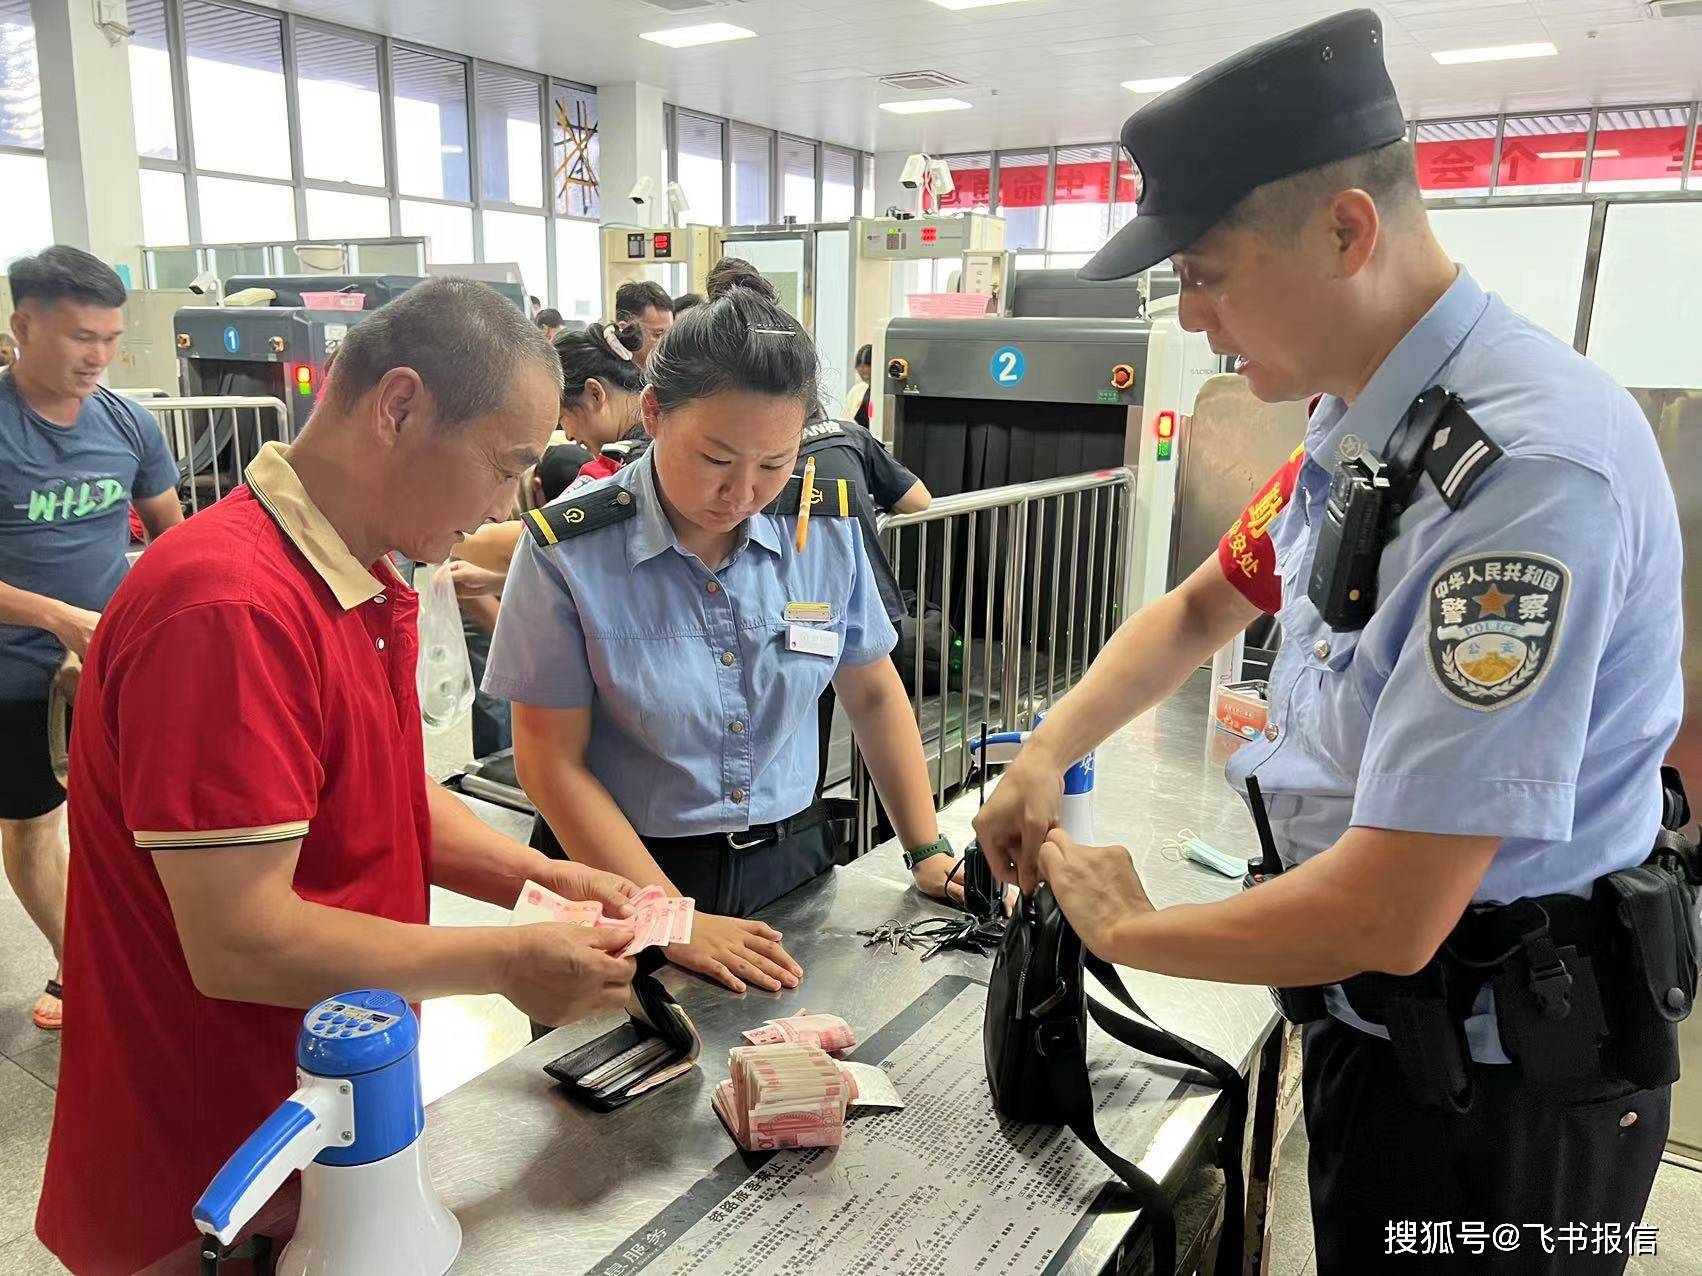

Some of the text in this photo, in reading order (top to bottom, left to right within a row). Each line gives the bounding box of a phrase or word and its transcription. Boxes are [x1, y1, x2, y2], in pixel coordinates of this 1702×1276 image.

[227, 331, 236, 350] 1
[999, 352, 1018, 382] 2
[28, 478, 124, 522] WILD
[1435, 562, 1559, 598] 中华人民共和国
[1441, 593, 1549, 624] 警 察
[1463, 622, 1519, 636] POLICE
[708, 1149, 799, 1223] 铁路旅客禁止、
